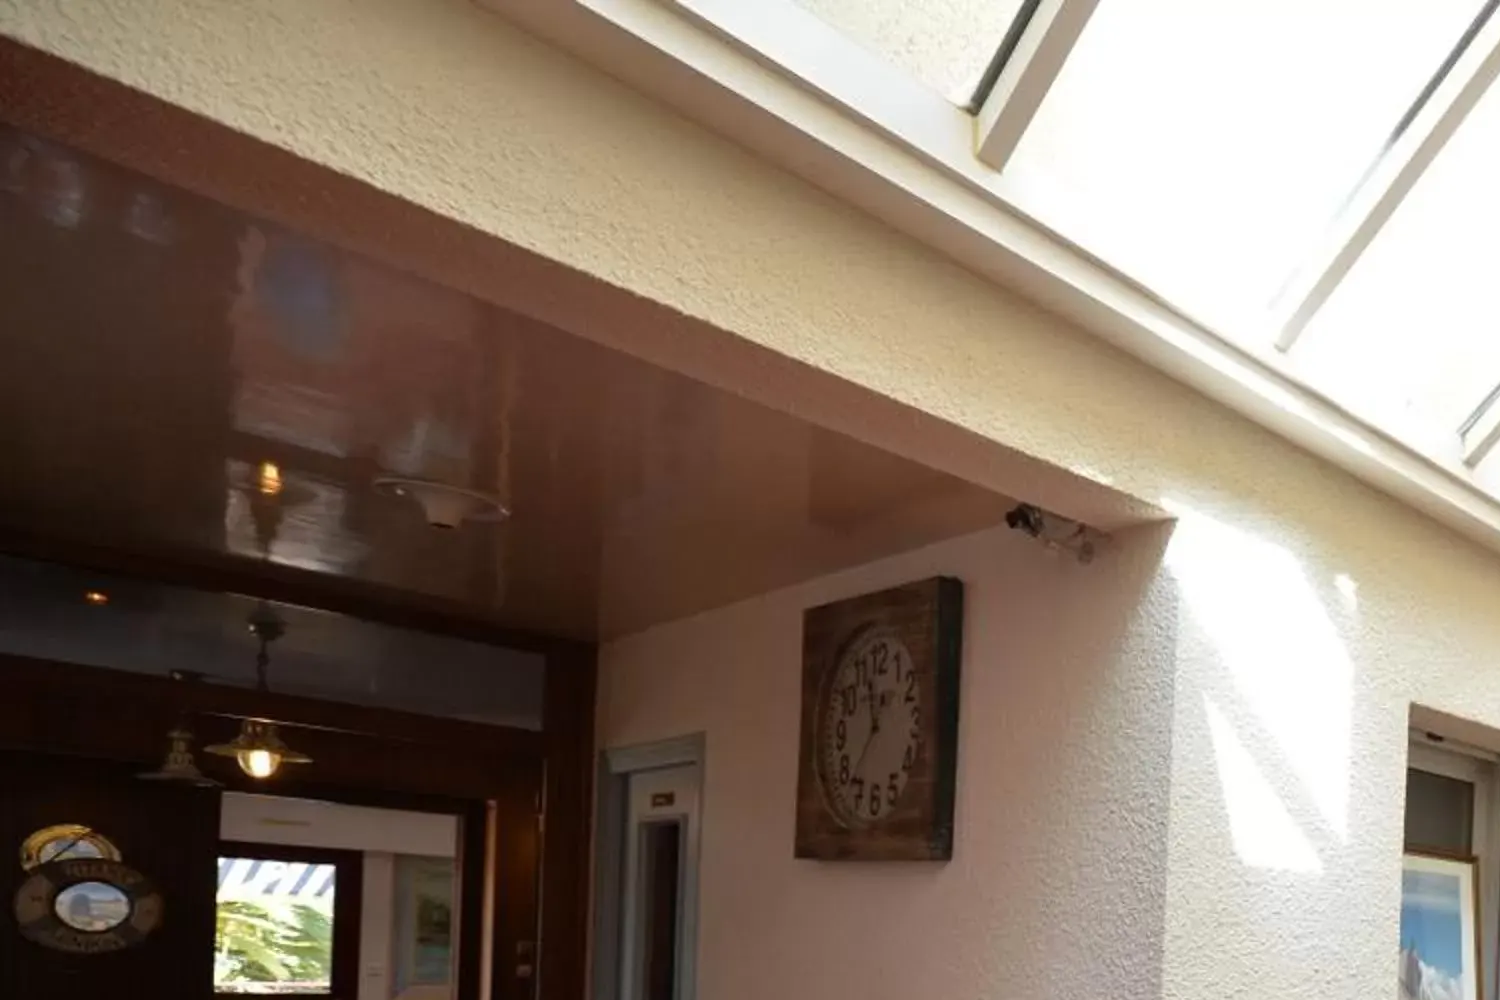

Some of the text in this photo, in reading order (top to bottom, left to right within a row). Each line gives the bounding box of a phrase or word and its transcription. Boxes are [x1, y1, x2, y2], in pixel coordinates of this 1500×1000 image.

[871, 643, 887, 675] 12
[893, 652, 901, 682] 1
[905, 671, 915, 702] 2
[837, 719, 846, 751] 9
[910, 706, 919, 738] 3
[840, 754, 849, 785] 8
[902, 745, 912, 770] 4
[851, 776, 864, 809] 7
[870, 784, 881, 816] 6
[887, 773, 898, 807] 5
